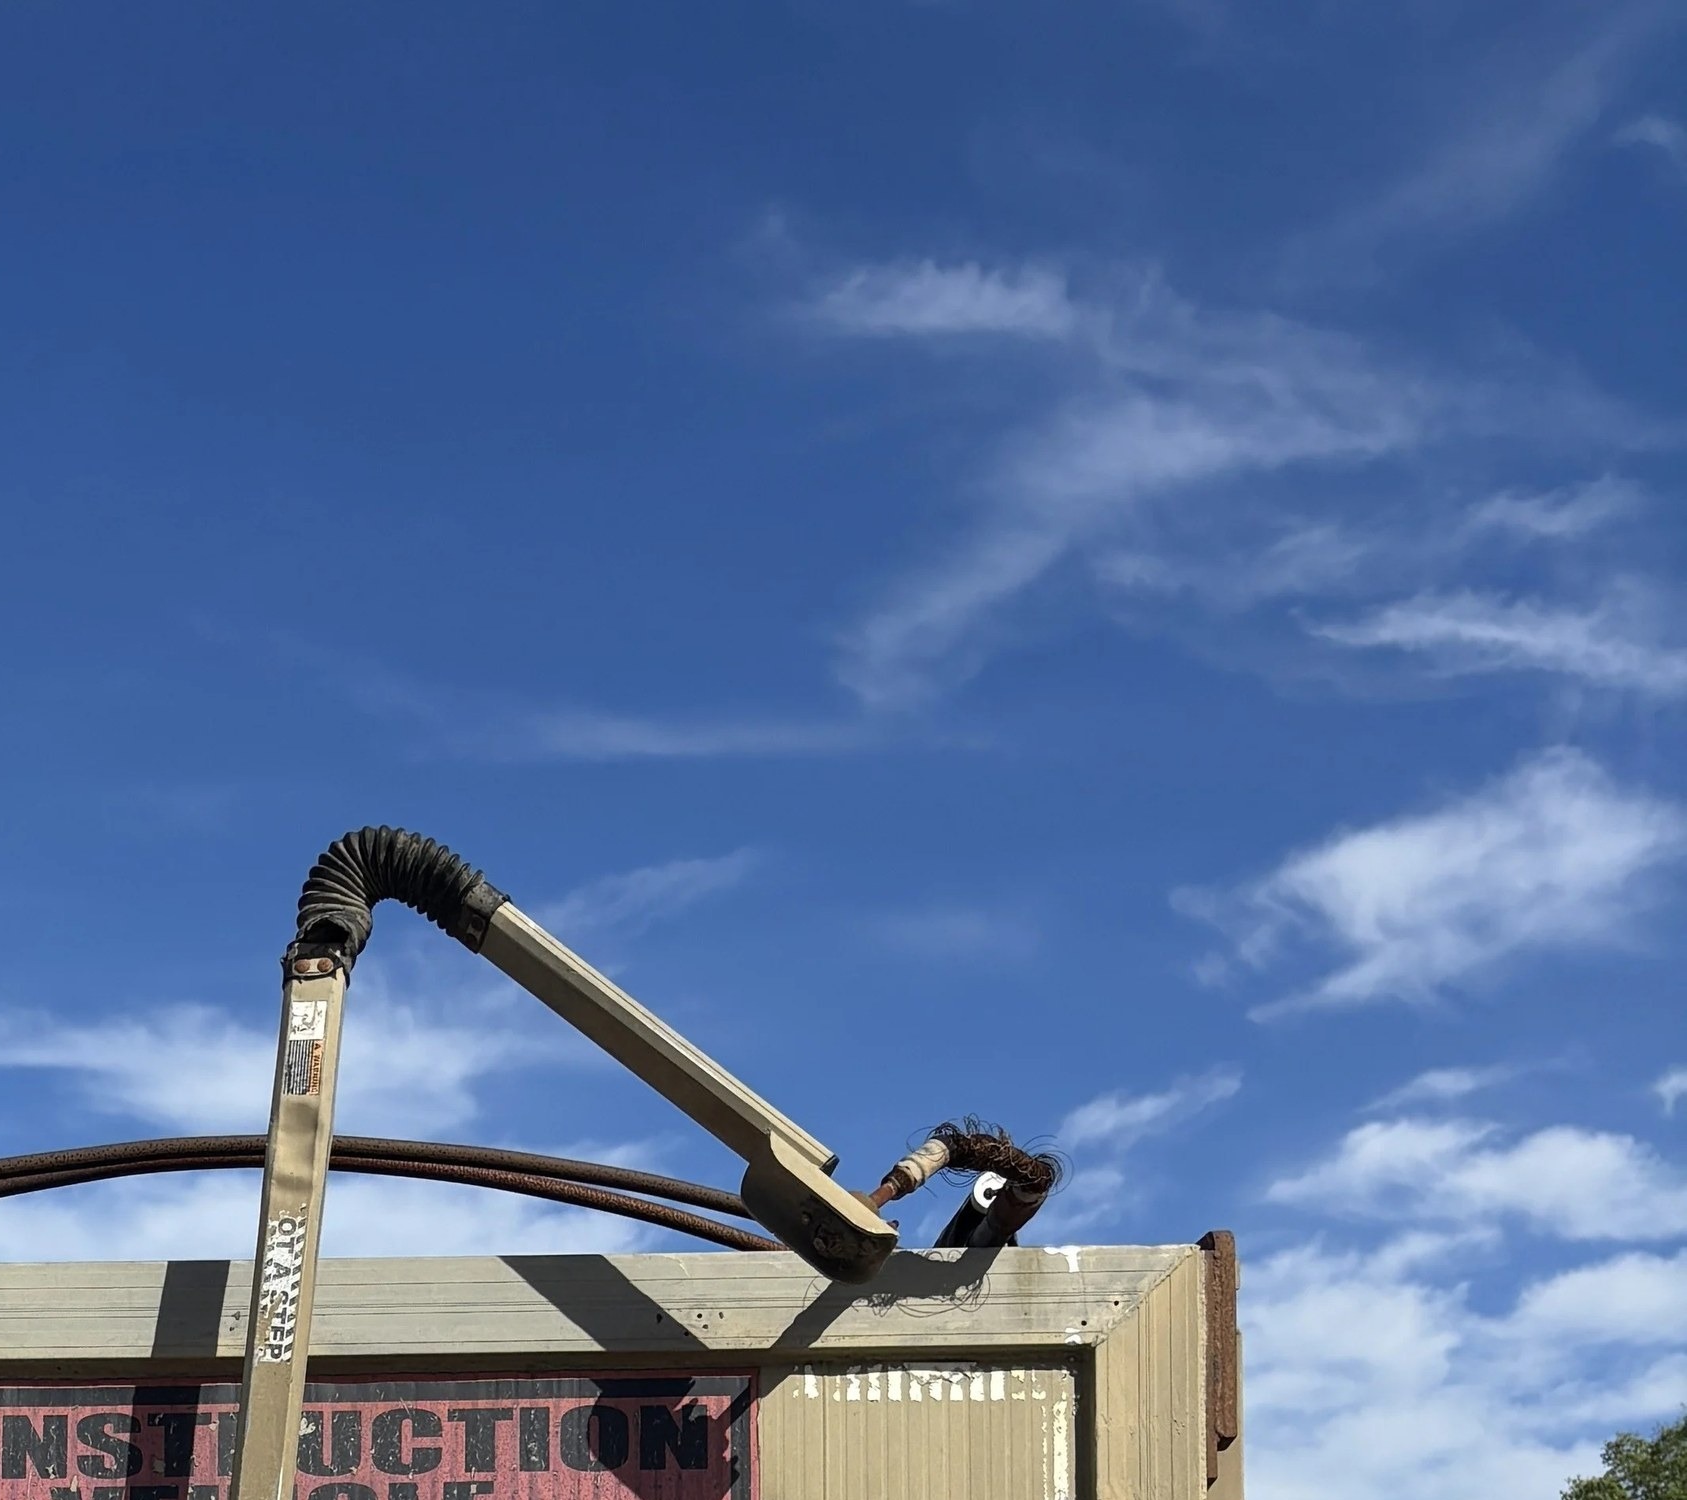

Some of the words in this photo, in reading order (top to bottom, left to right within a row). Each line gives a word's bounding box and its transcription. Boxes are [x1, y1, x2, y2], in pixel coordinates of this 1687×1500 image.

[275, 1216, 298, 1254] OT
[271, 1262, 292, 1281] A
[263, 1290, 290, 1361] STEP
